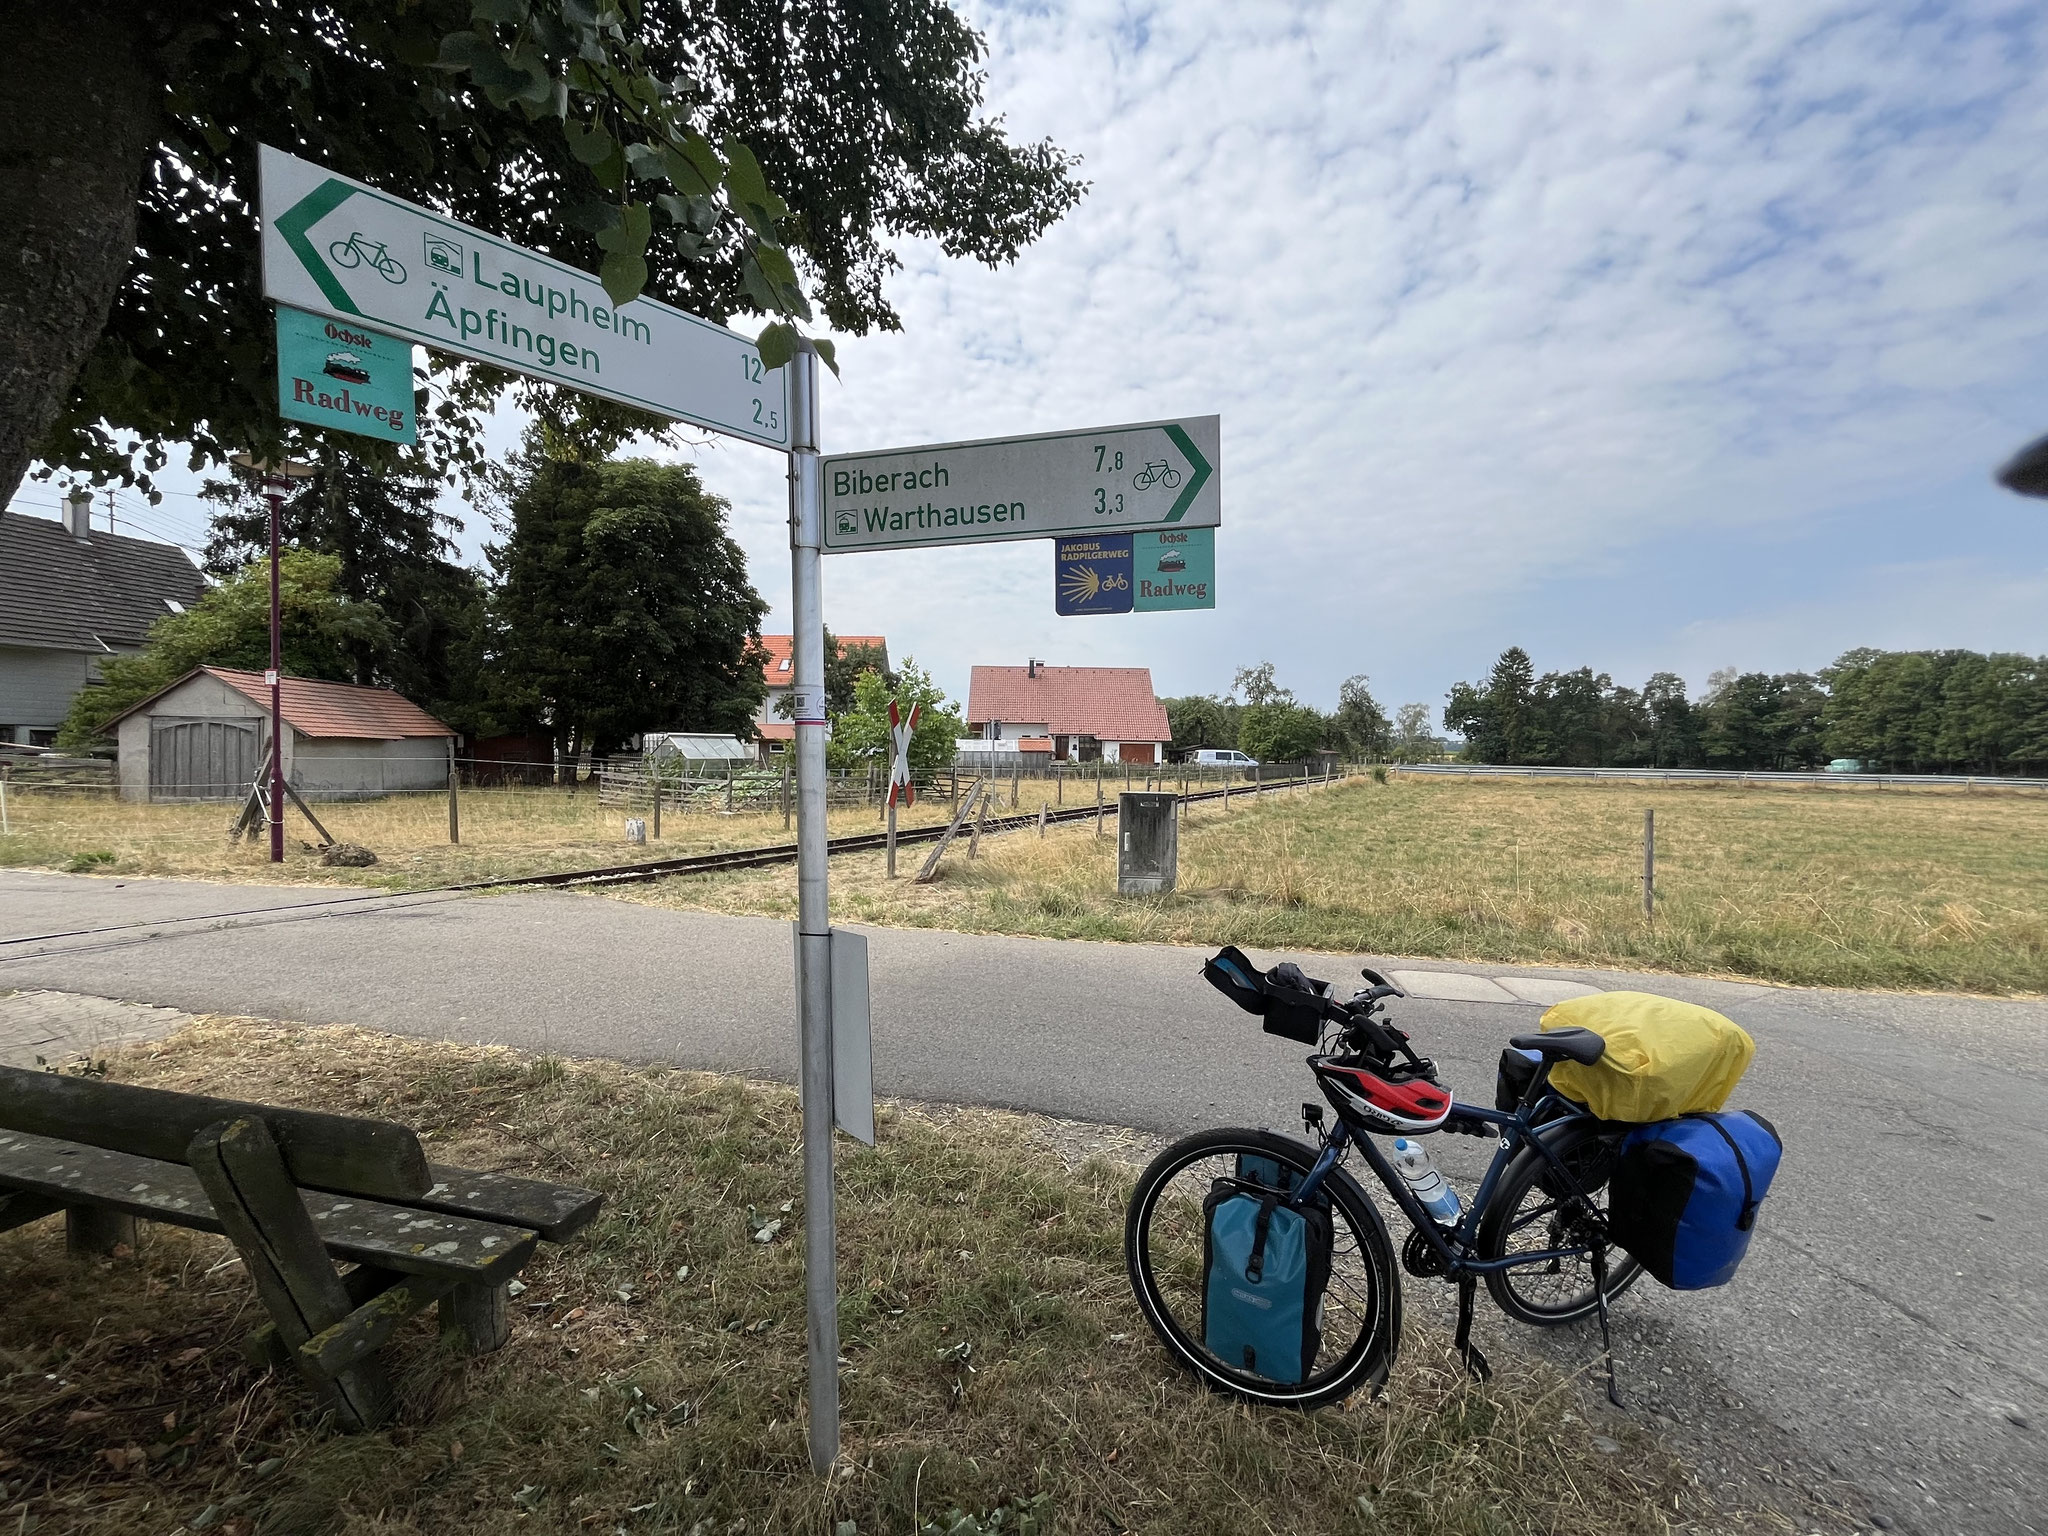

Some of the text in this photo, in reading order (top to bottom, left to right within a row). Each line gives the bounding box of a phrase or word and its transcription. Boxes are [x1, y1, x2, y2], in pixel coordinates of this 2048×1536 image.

[474, 250, 762, 385] Laupheim 12
[424, 281, 778, 430] Äpfingen 2,5
[292, 376, 404, 431] Radweg
[834, 445, 1124, 497] Biberach 7,8
[864, 487, 1124, 533] Warthausen 3,3
[1061, 542, 1100, 552] JAKOBUS
[1061, 549, 1129, 561] RADPILGERWEG
[1140, 578, 1207, 599] Radweg
